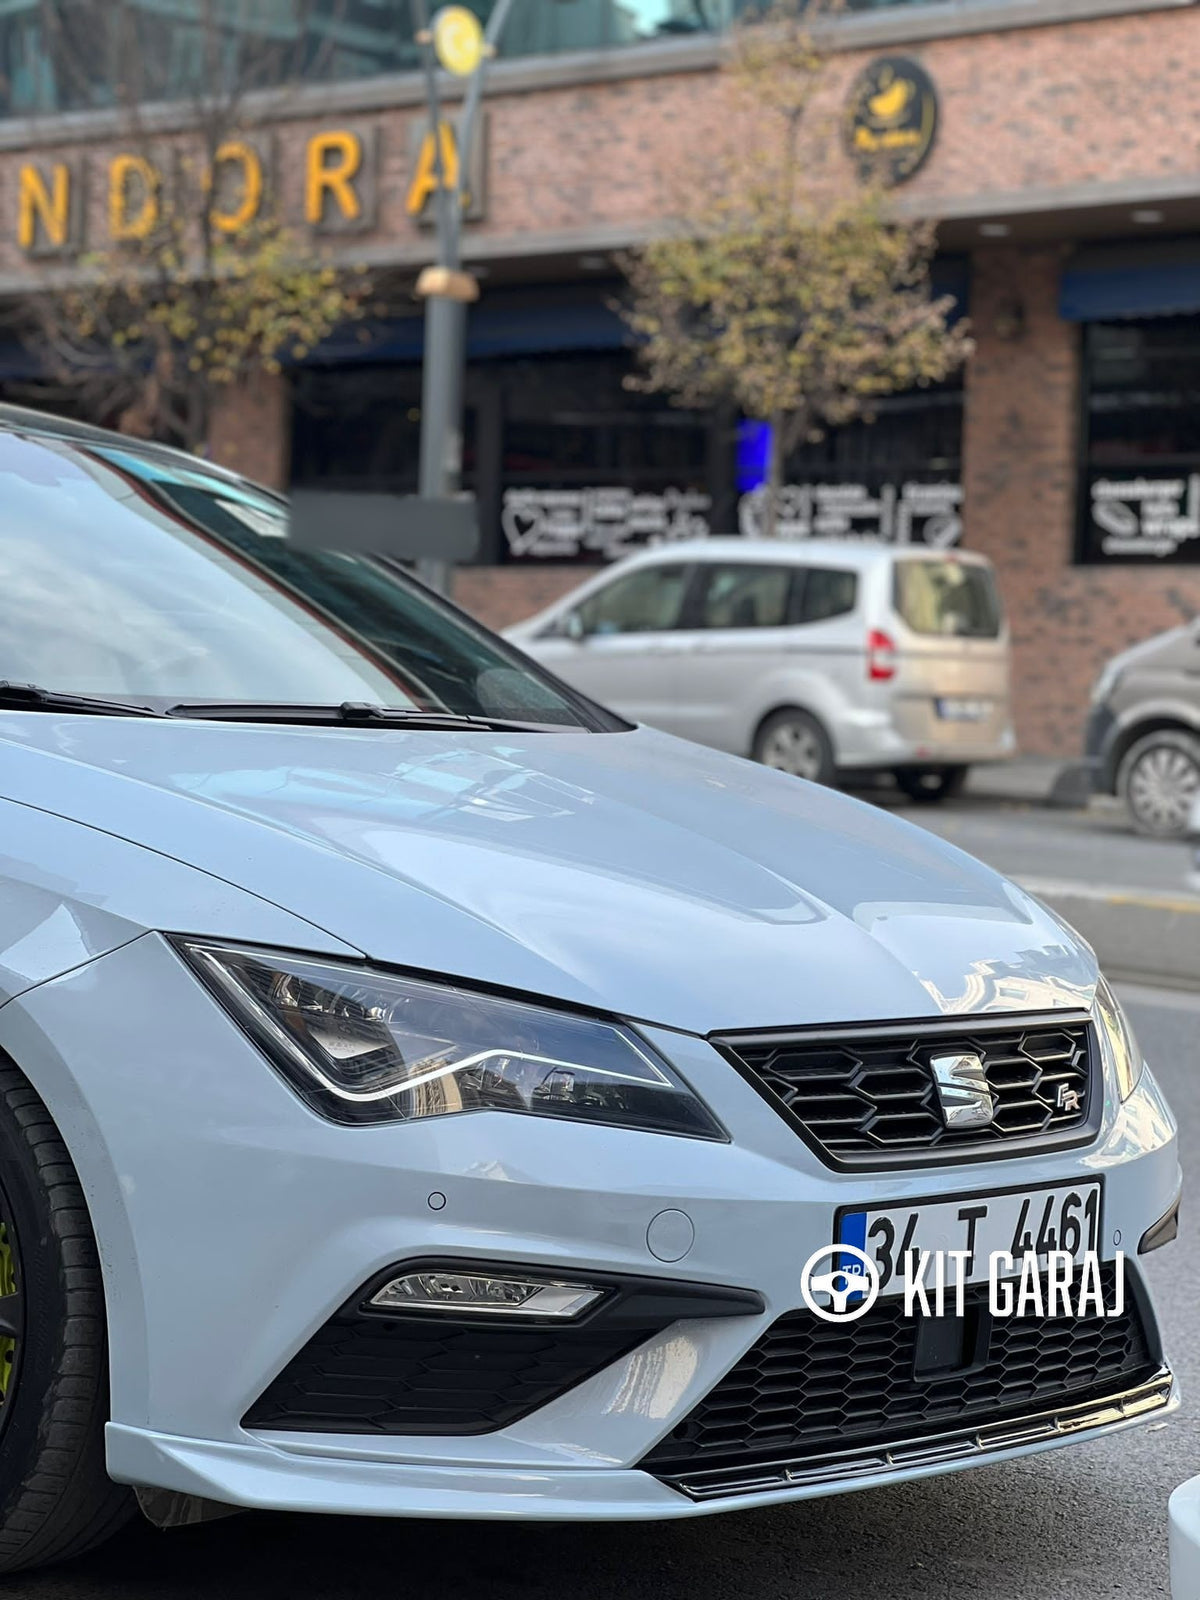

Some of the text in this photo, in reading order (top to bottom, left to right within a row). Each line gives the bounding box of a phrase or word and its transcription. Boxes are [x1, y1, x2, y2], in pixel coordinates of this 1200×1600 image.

[868, 1188, 1099, 1290] 34 T 4461
